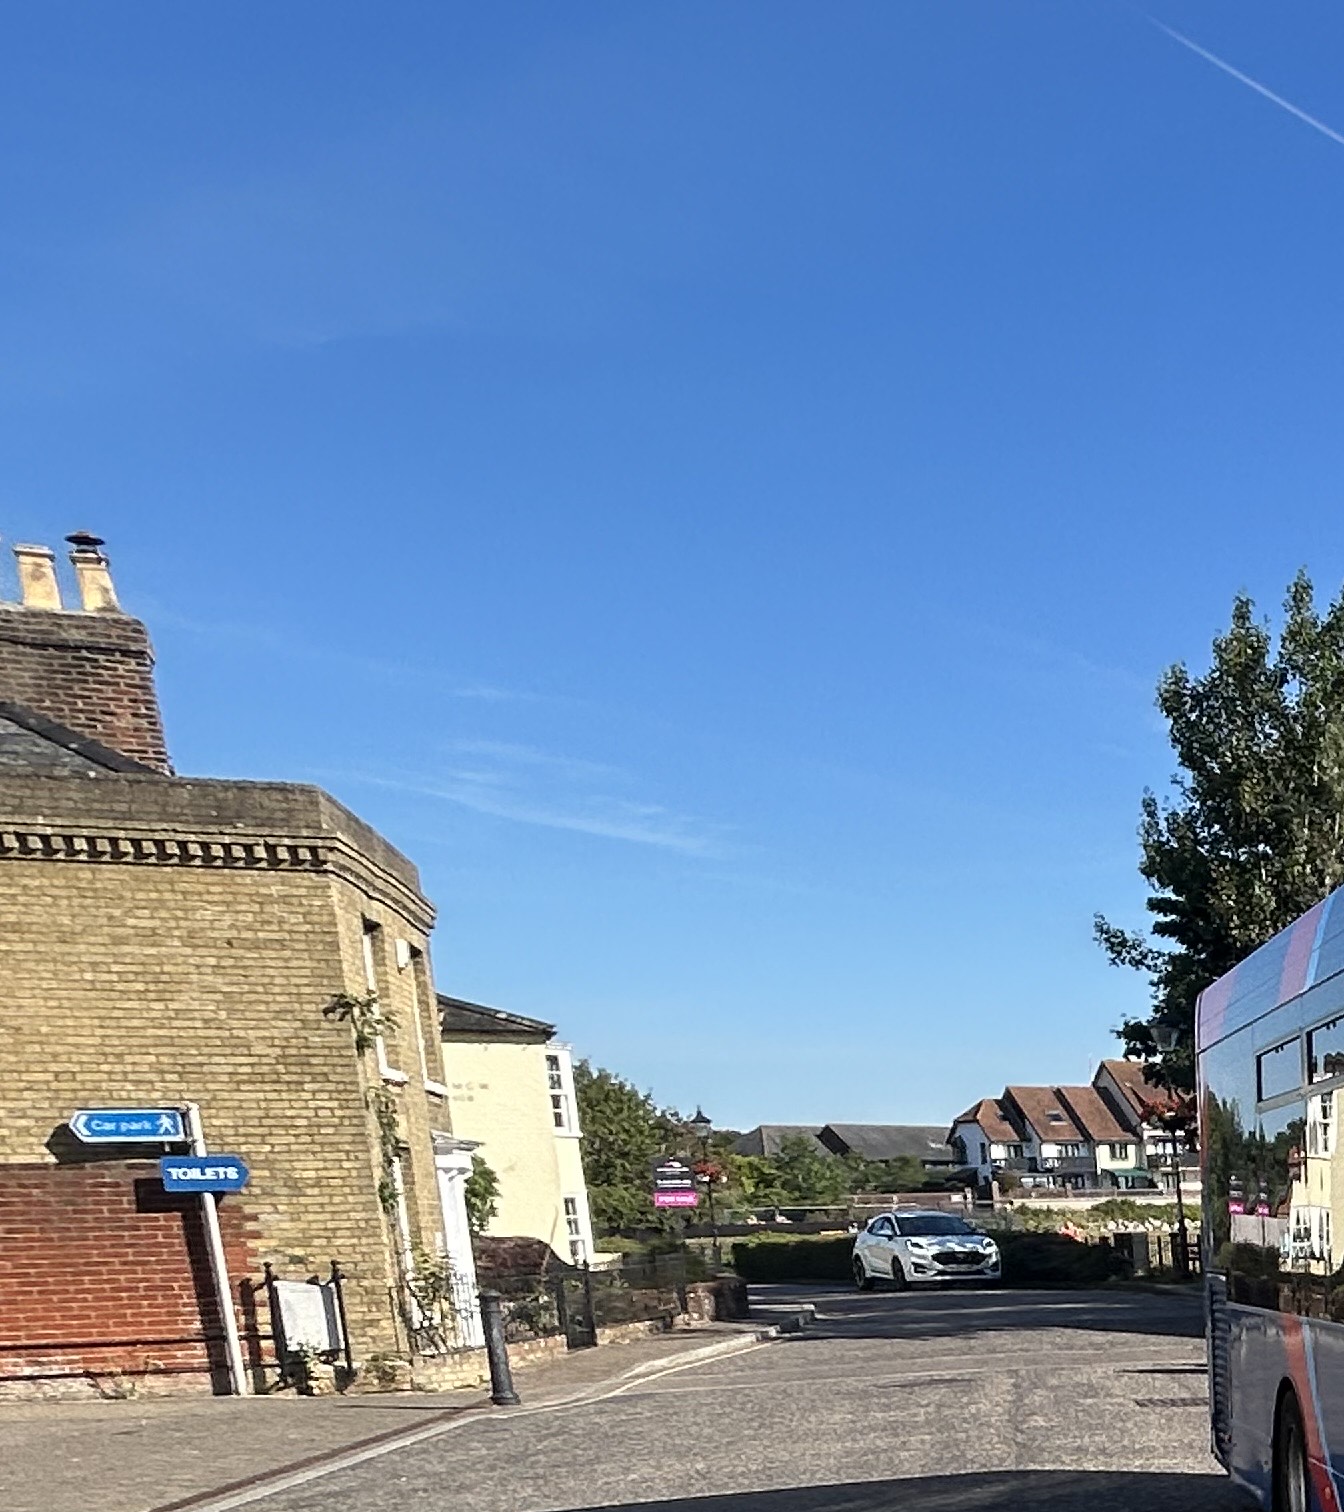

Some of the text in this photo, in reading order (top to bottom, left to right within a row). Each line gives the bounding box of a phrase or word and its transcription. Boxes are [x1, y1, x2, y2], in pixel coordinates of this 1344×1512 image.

[90, 1119, 152, 1132] Car park
[165, 1166, 239, 1180] TOILETS
